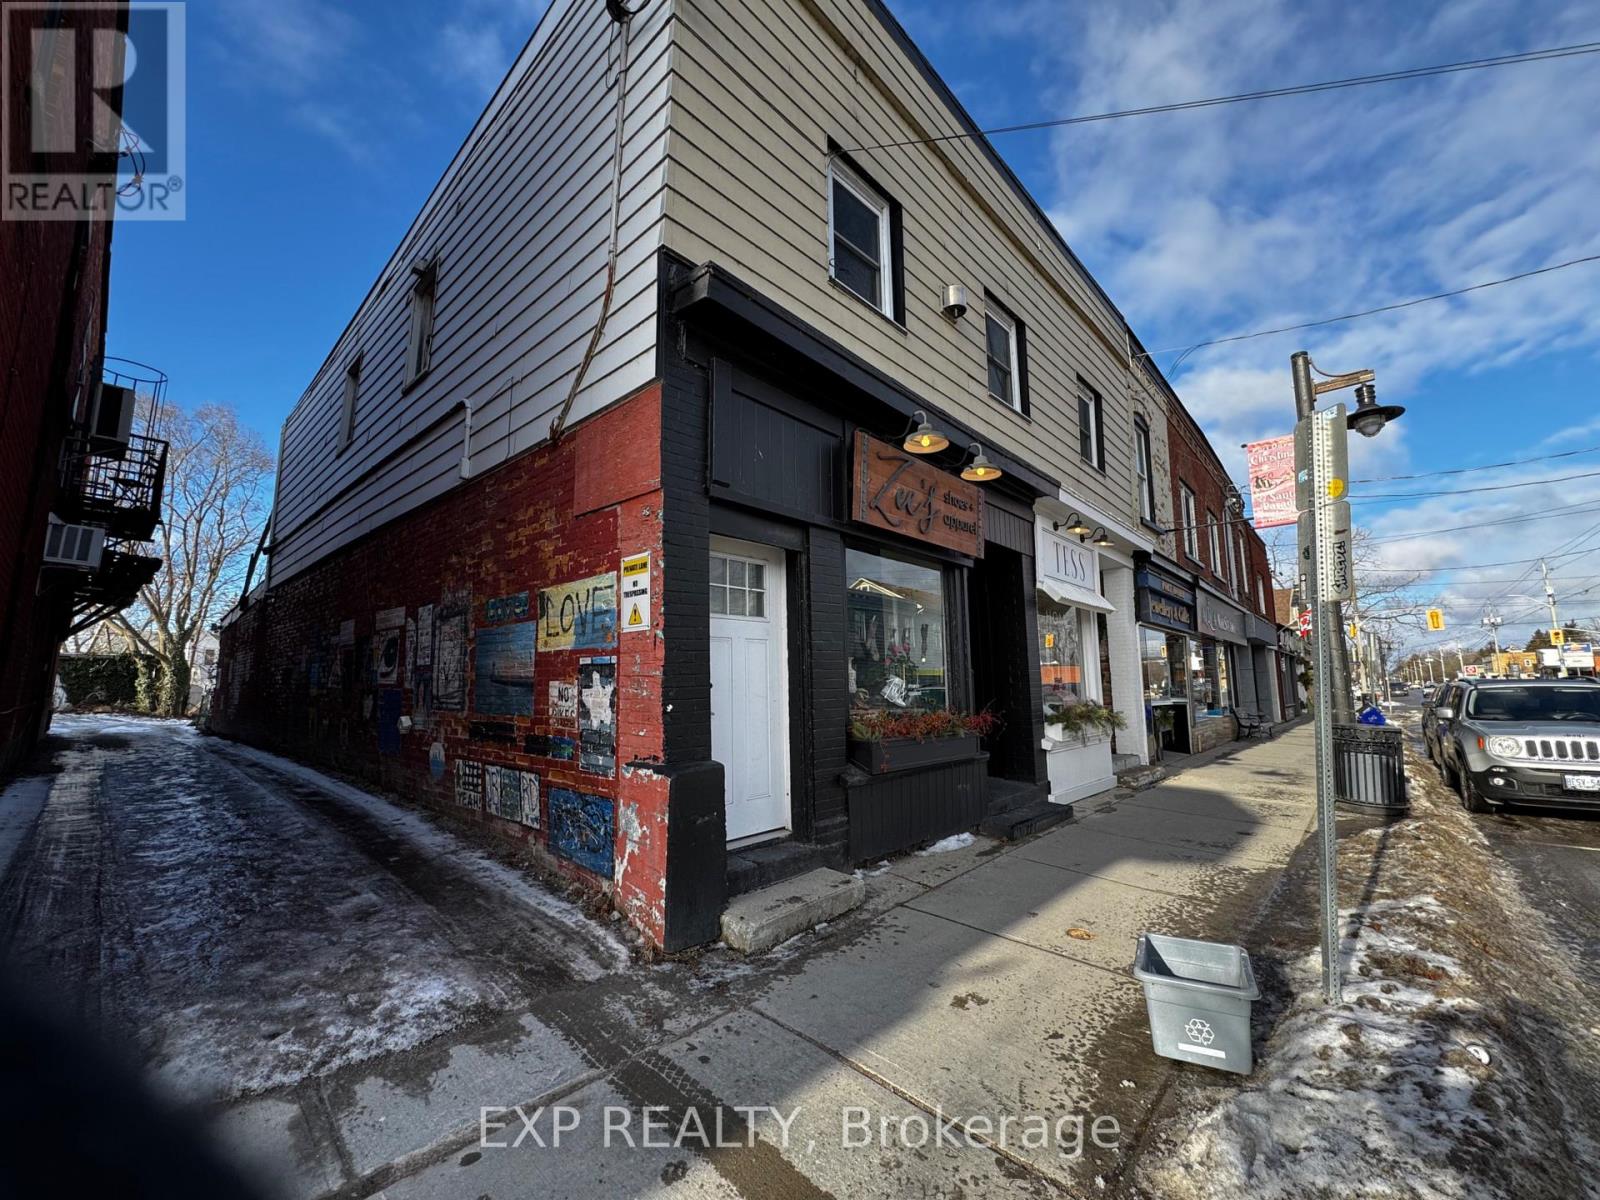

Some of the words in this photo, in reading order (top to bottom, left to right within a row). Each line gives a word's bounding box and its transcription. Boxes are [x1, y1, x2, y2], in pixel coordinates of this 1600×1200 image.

[1053, 541, 1086, 581] TESS
[546, 584, 615, 637] LOVE
[558, 686, 569, 702] NO
